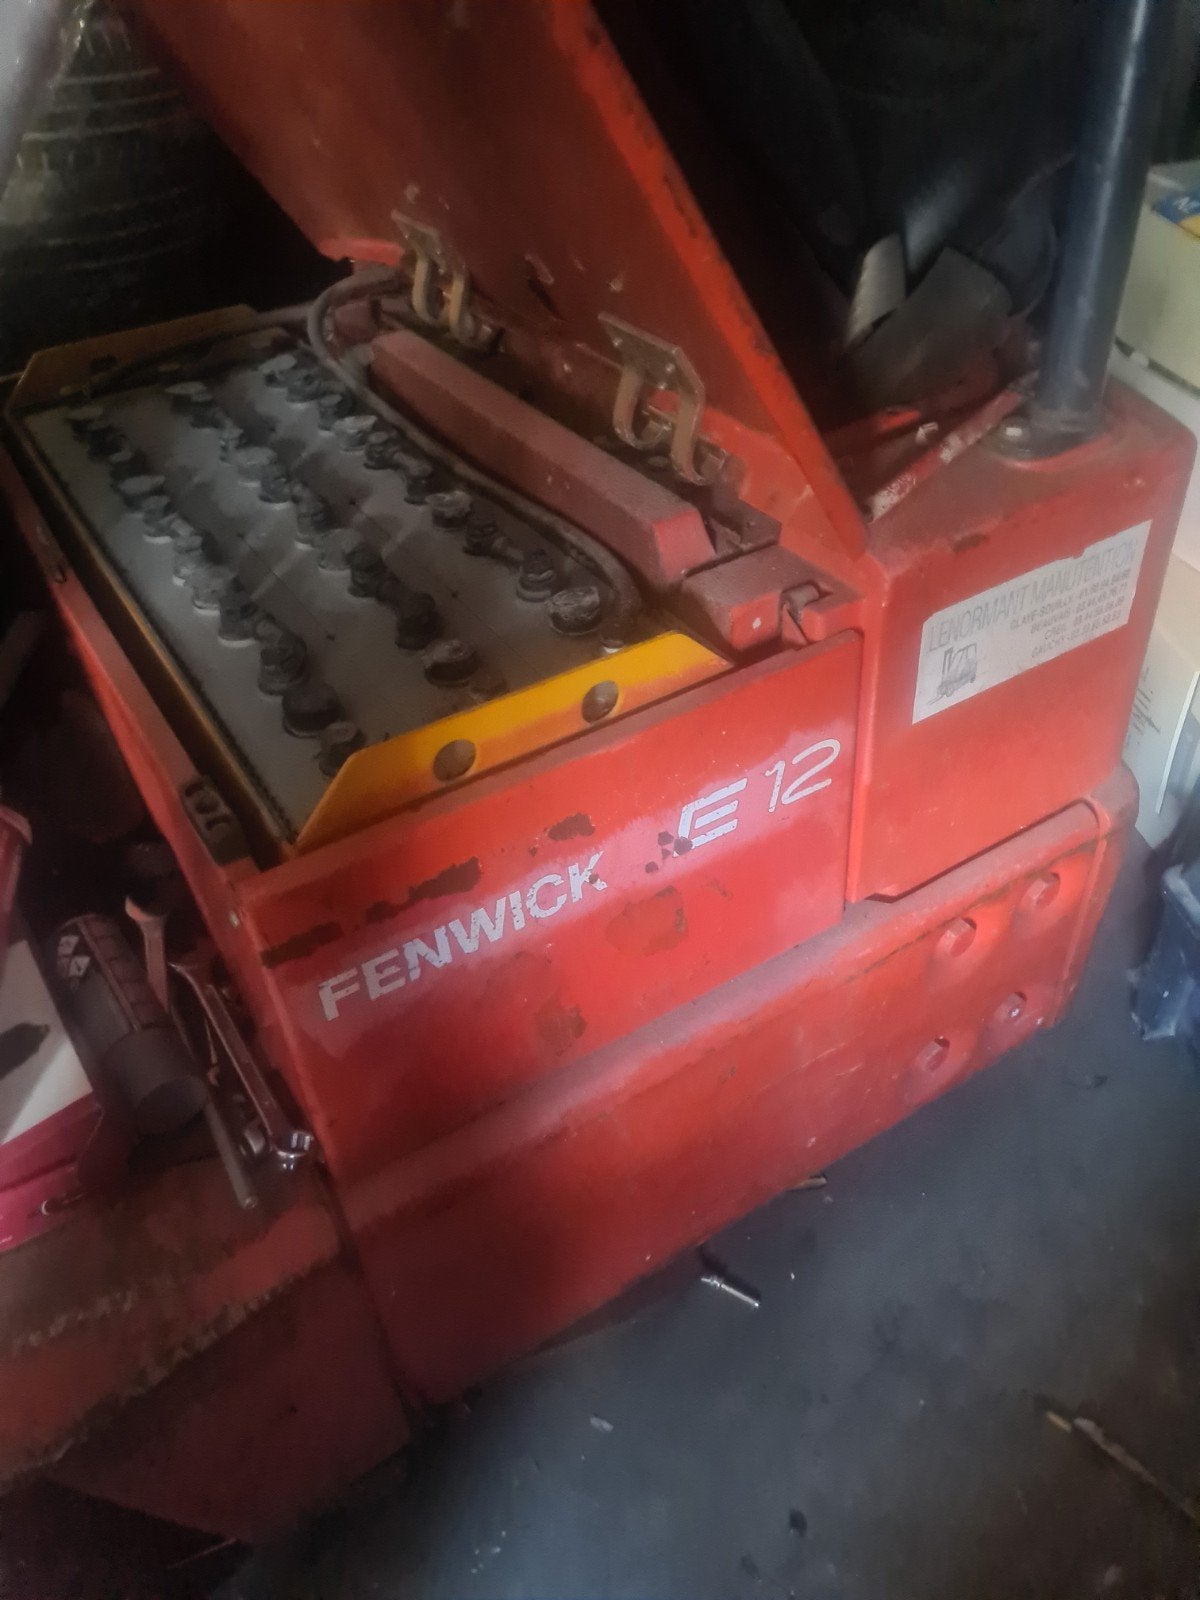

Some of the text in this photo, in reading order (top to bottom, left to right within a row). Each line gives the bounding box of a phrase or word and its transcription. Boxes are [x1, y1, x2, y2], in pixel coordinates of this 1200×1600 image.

[928, 584, 1028, 652] LENORMANT
[317, 738, 841, 1021] FENWICK E 12
